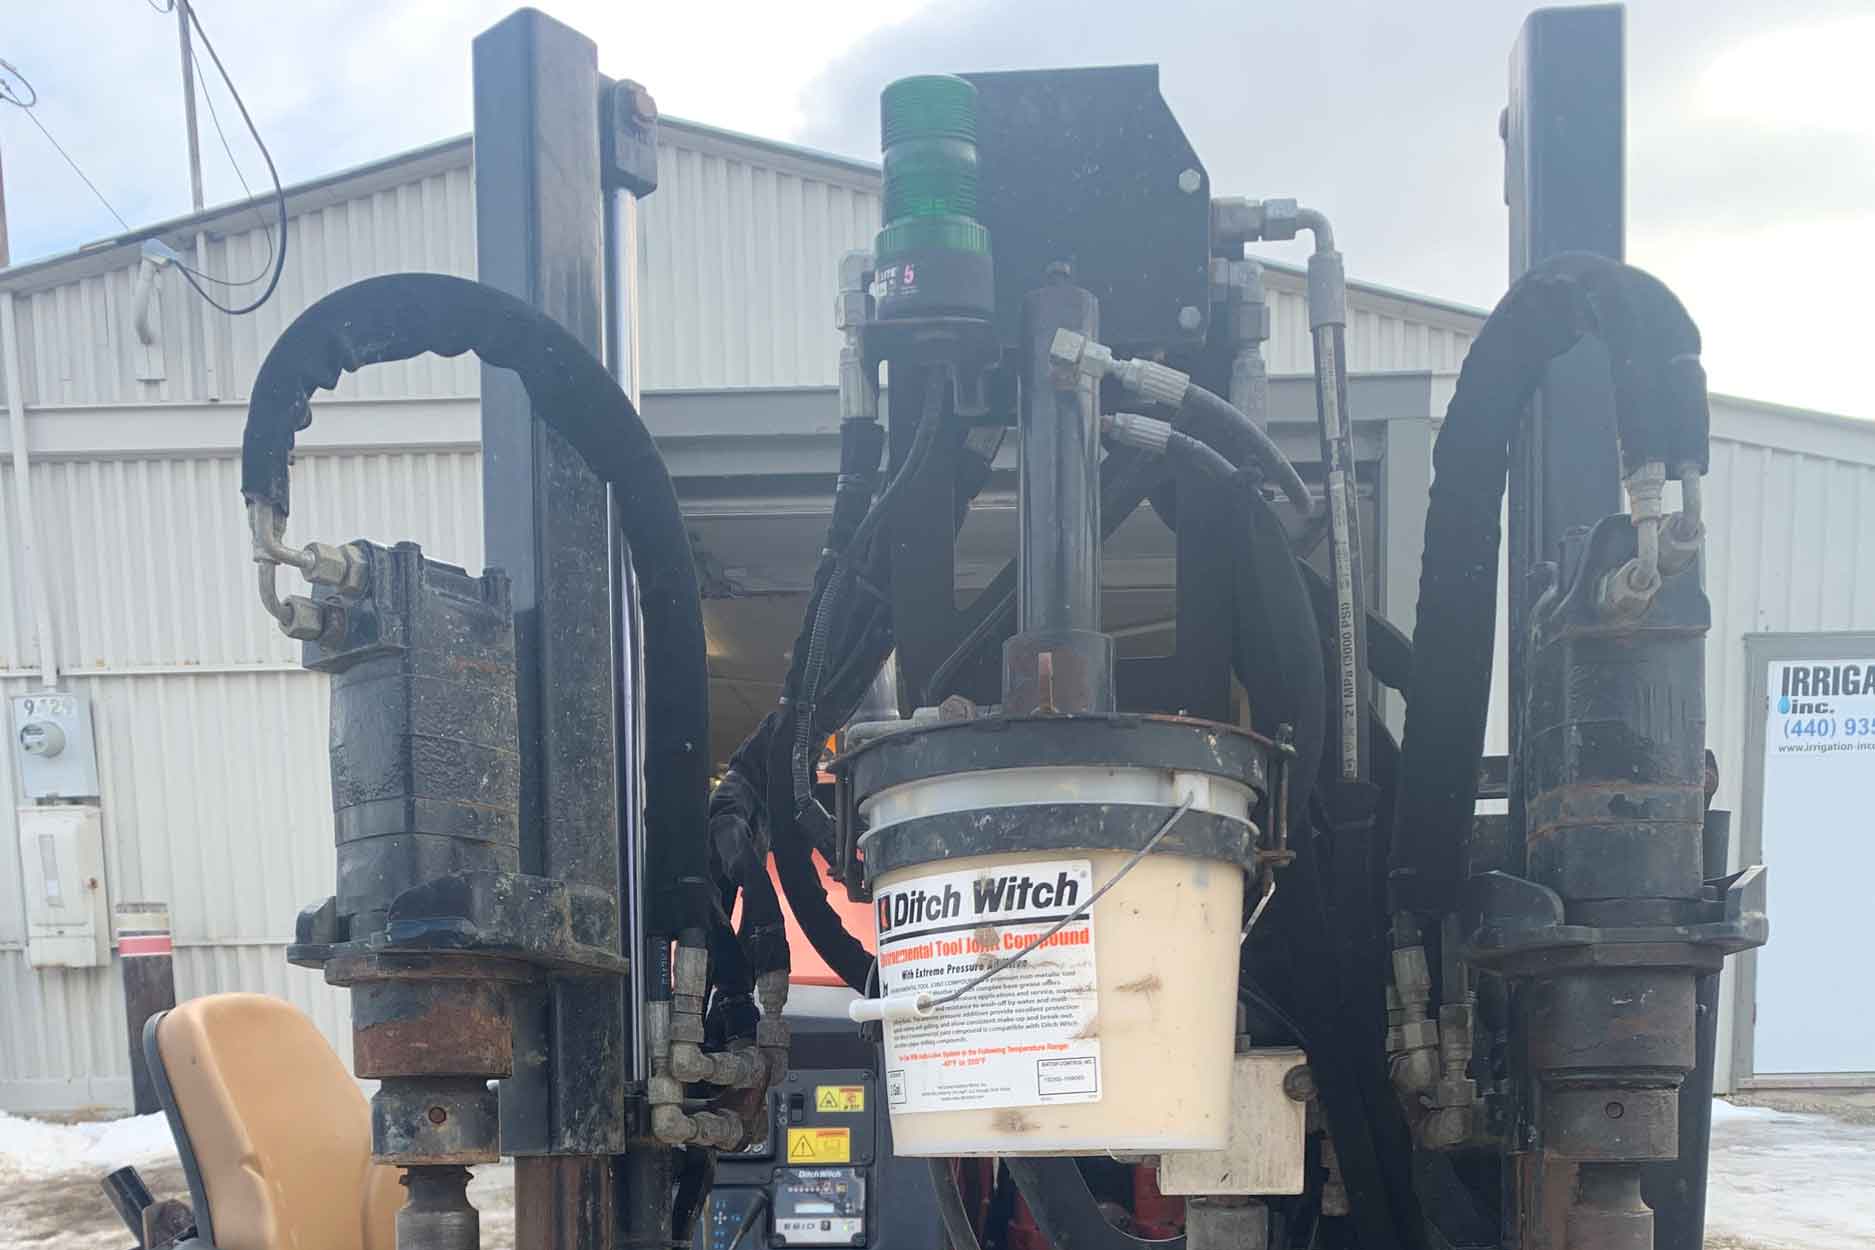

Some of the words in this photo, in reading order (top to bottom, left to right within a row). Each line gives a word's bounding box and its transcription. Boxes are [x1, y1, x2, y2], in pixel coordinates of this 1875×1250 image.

[1791, 699, 1836, 715] inc.
[1784, 718, 1837, 739] (440)
[894, 884, 961, 928] Ditch
[973, 871, 1080, 915] Witch
[936, 937, 963, 957] Tool
[915, 965, 945, 979] Extreme
